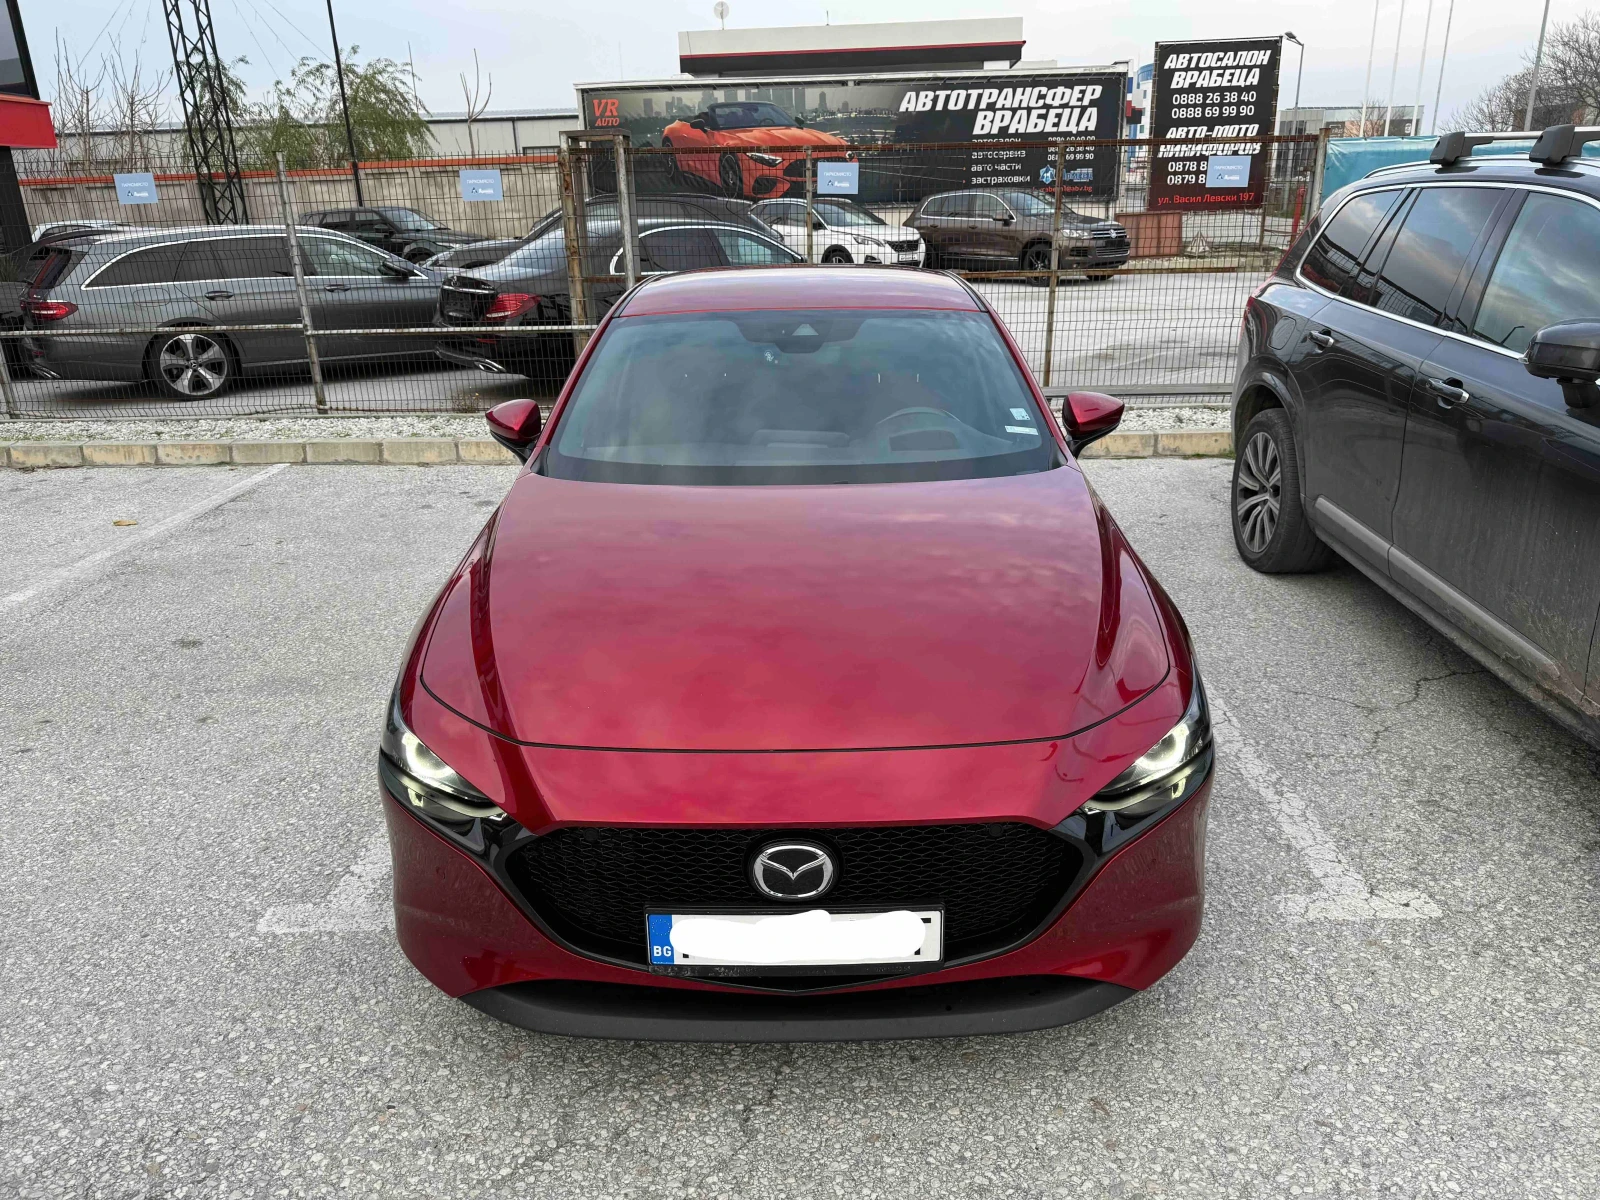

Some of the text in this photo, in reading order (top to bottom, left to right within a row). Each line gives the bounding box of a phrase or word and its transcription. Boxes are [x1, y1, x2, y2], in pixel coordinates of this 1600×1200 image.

[1164, 50, 1271, 69] АВТОСАЛОН
[1170, 68, 1260, 88] ВРАБЕЦА
[899, 85, 1103, 112] АВТОТРАНСФЕР
[1172, 91, 1256, 105] 0888 26 38 40
[592, 98, 619, 117] VR
[1171, 105, 1254, 119] 0888 69 99 90
[595, 117, 620, 127] AUTO
[972, 107, 1098, 135] ВРАБЕЦА
[1165, 124, 1259, 139] АВТО-МОТО
[971, 150, 1026, 160] автосервиз
[971, 163, 1022, 172] авто части
[1168, 161, 1197, 172] 0878
[971, 175, 1031, 186] застраховки
[1167, 174, 1196, 186] 0879
[1157, 192, 1255, 206] ул. Васил Левски 197
[653, 945, 672, 957] BG
